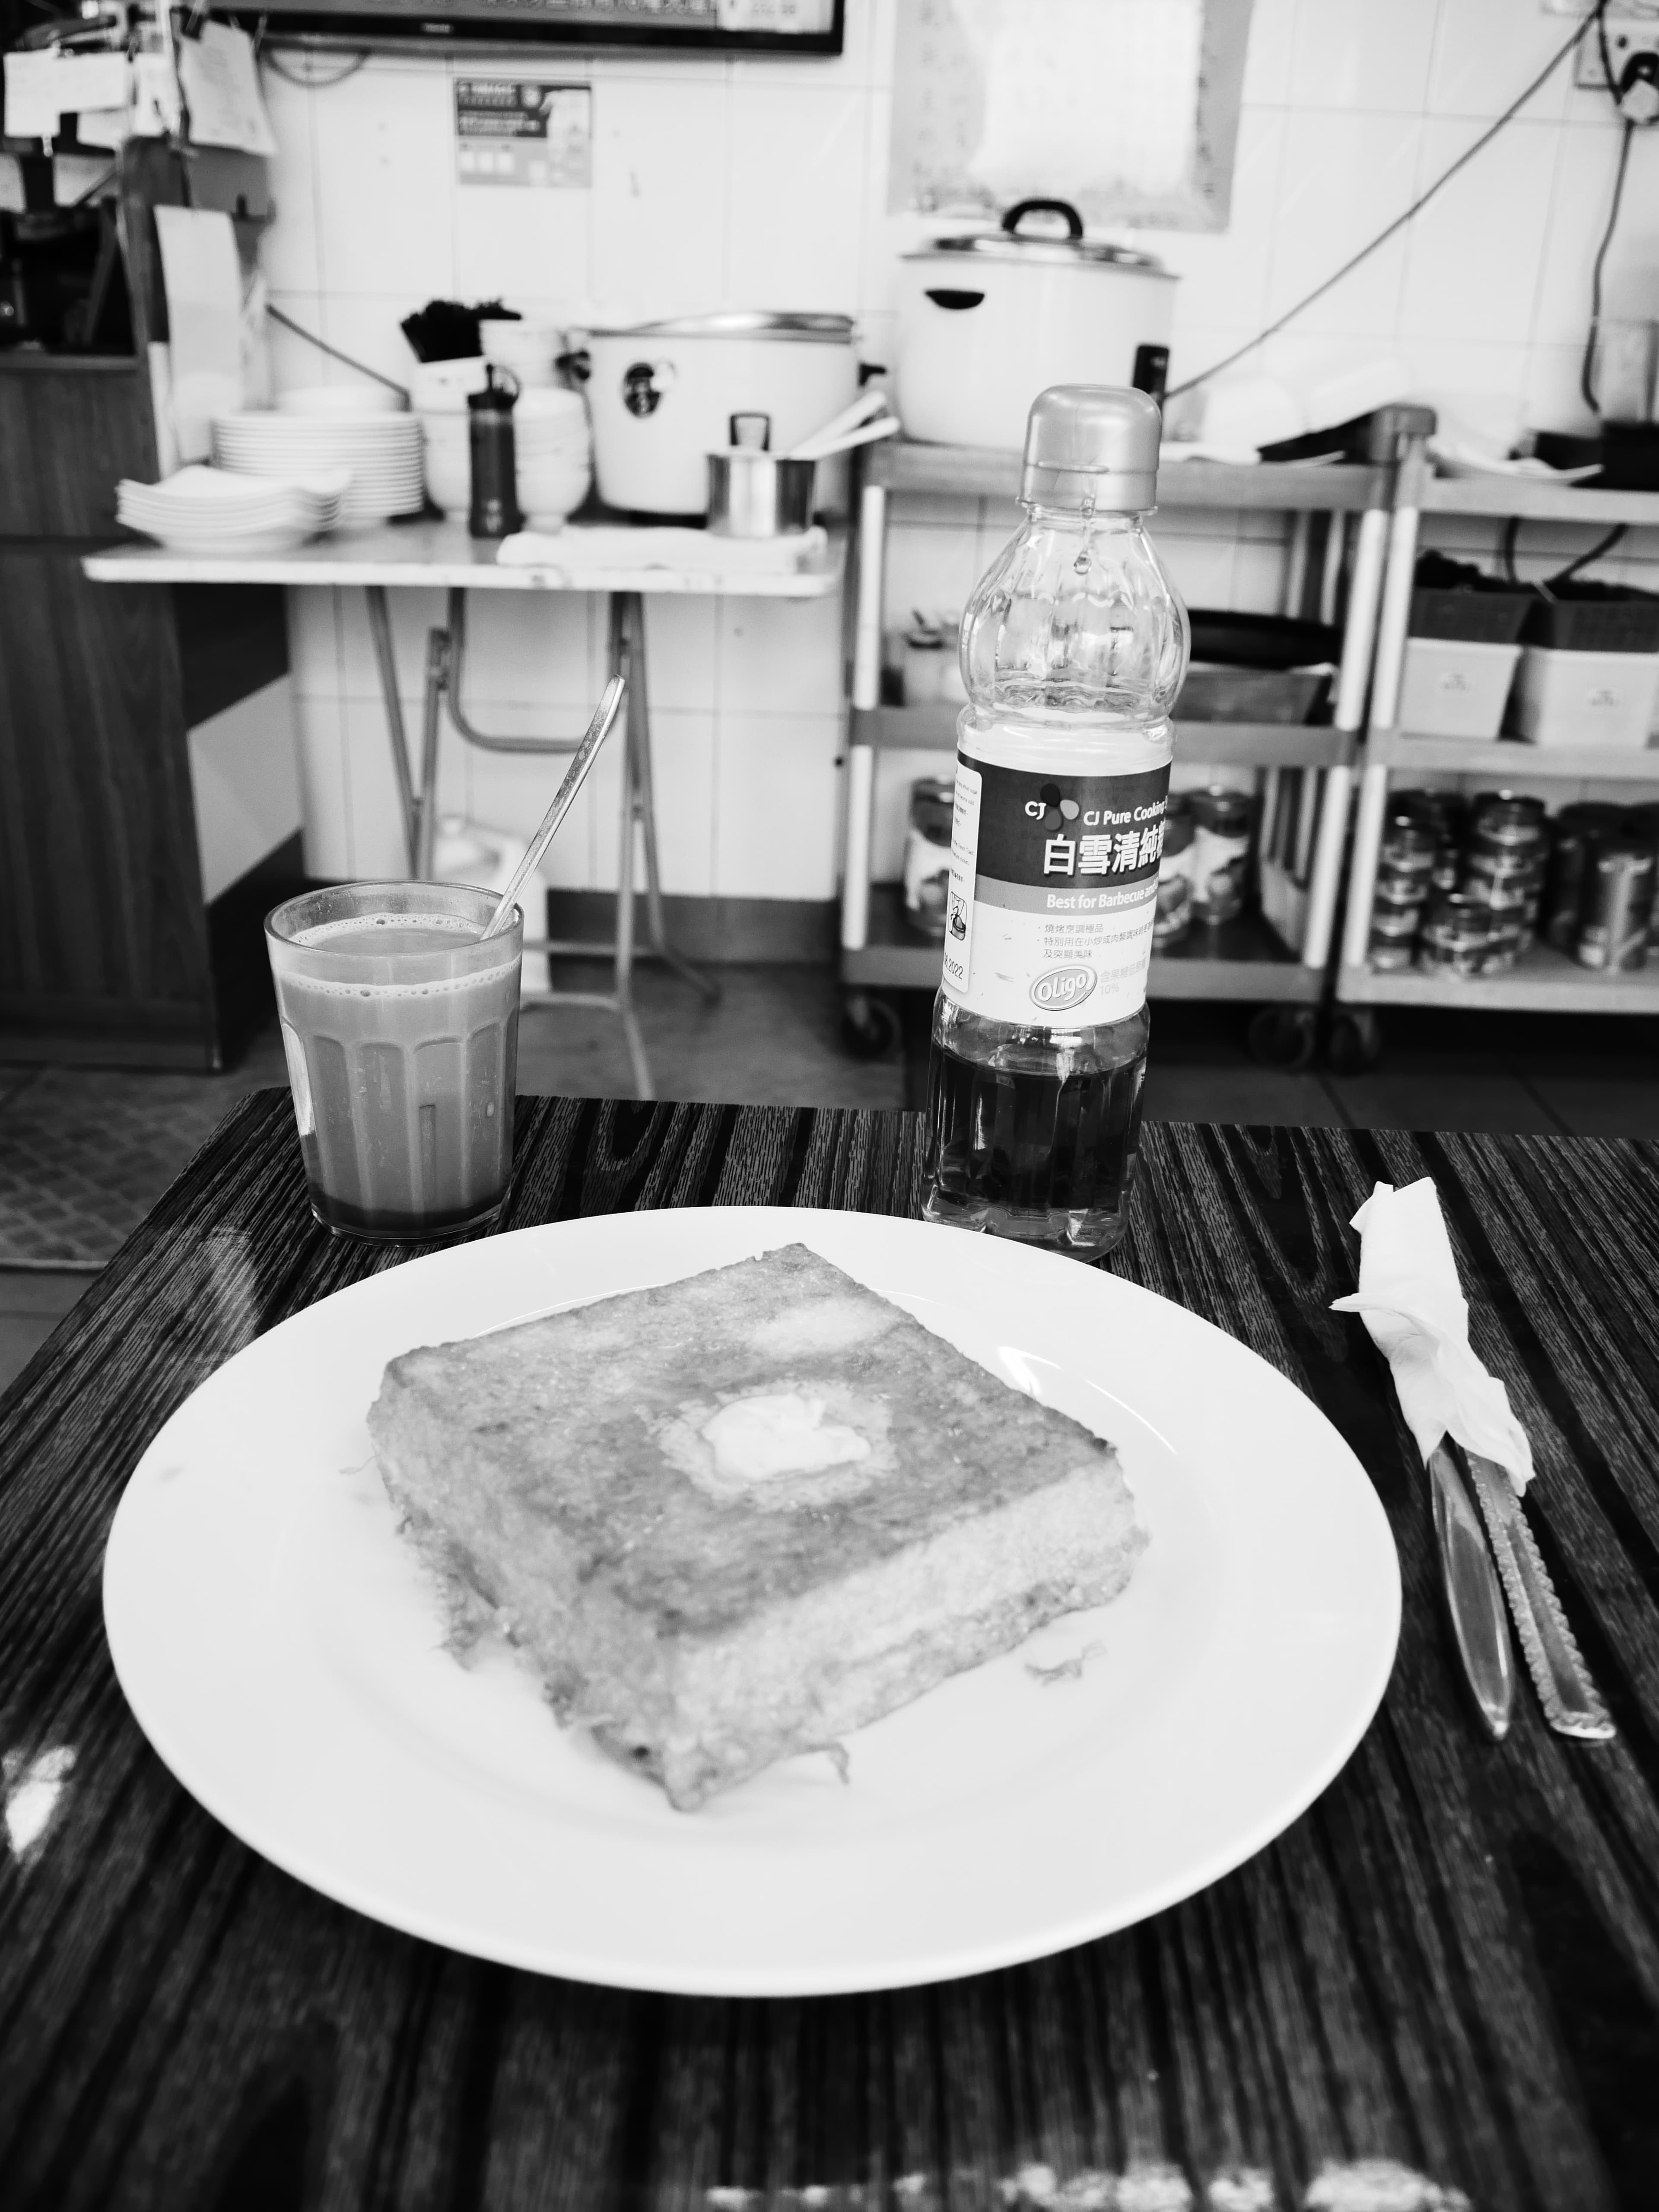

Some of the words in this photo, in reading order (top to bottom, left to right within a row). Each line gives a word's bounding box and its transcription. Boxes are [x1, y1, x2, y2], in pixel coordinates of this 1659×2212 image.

[1025, 801, 1046, 820] CJ
[1084, 811, 1100, 826] CJ
[1103, 810, 1131, 825] Pure
[1134, 801, 1165, 821] Cooking
[1047, 894, 1076, 909] Best
[1078, 895, 1097, 908] for
[1099, 890, 1144, 908] Barbecue
[1045, 924, 1103, 934] 燒烤烹調極品
[1043, 949, 1093, 959] 及突顯美味
[1038, 973, 1087, 1001] Oligo
[1101, 983, 1119, 995] 10%
